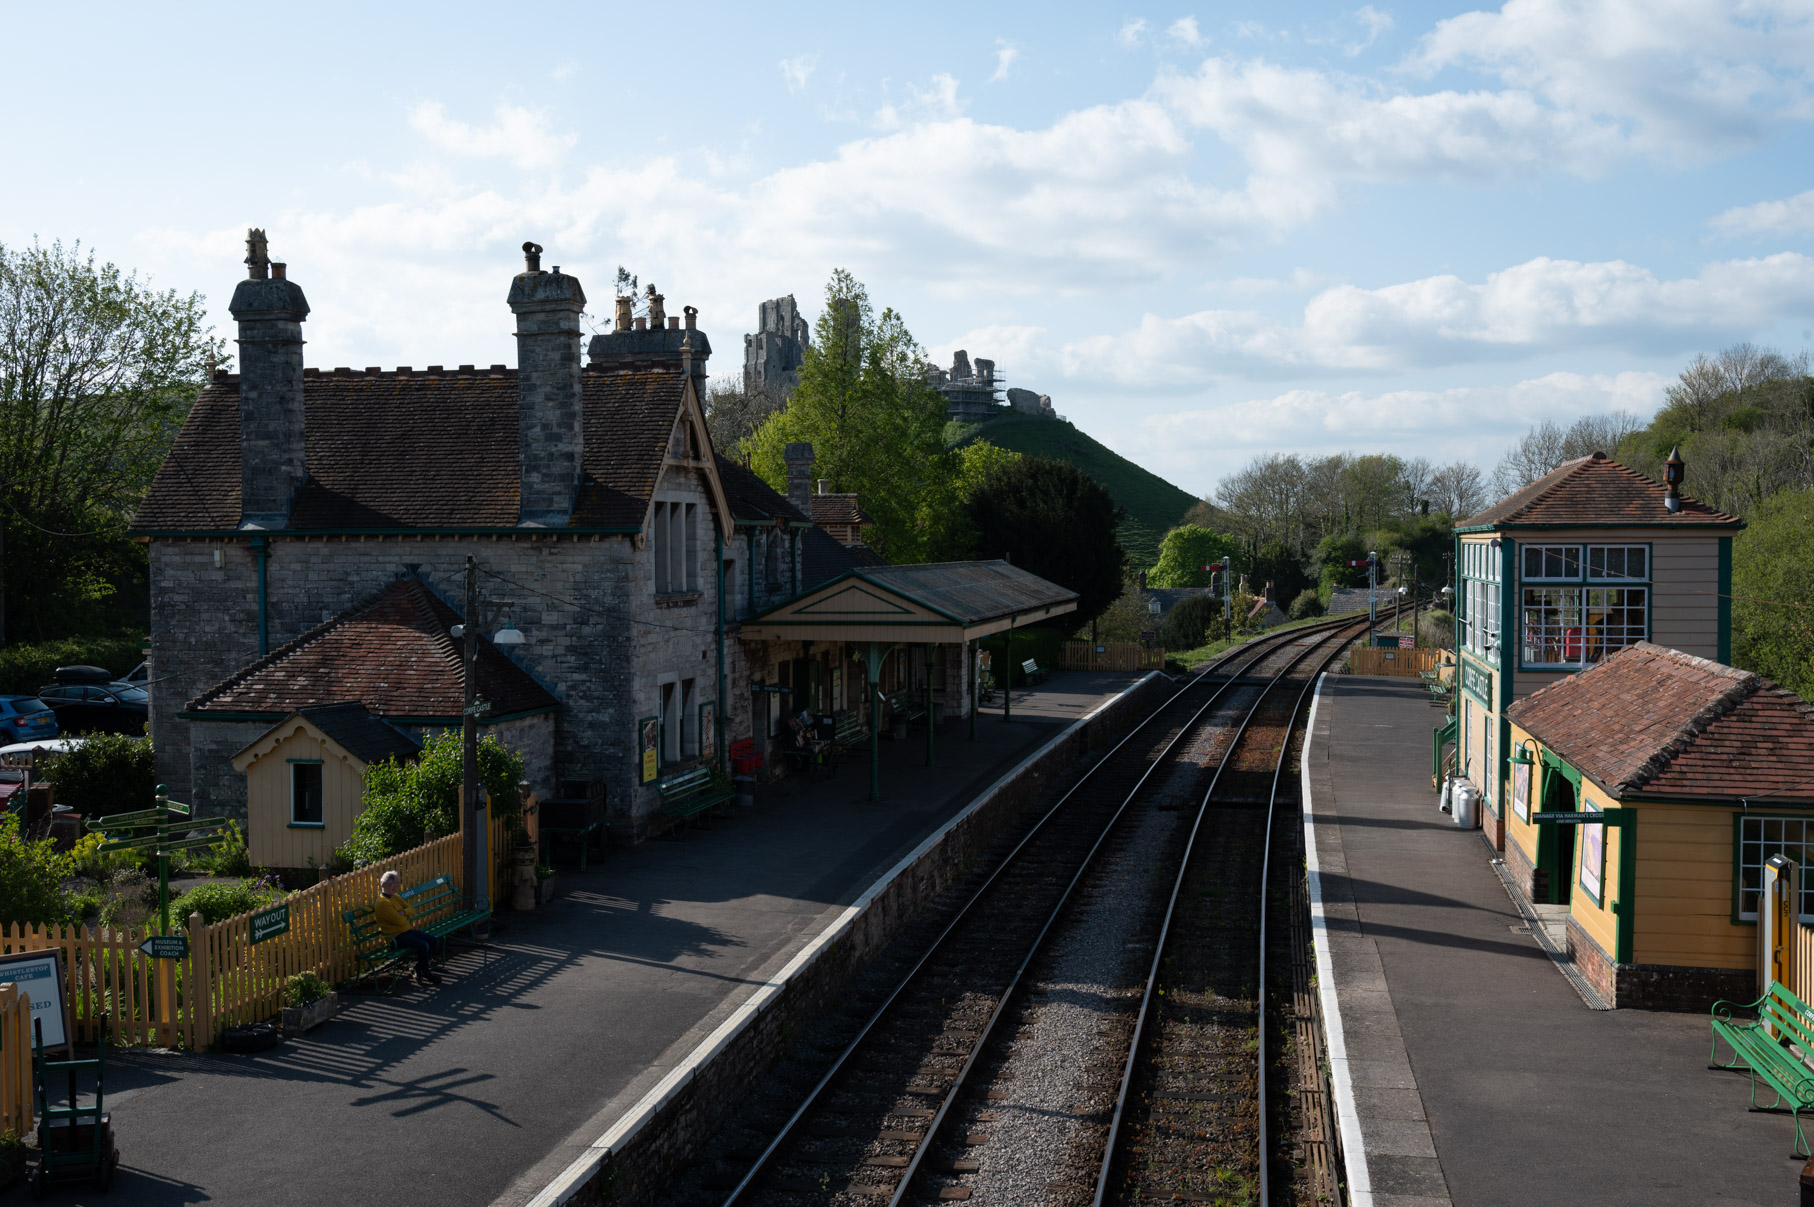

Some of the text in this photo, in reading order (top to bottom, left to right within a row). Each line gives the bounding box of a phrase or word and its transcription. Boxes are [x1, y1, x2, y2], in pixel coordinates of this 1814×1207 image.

[1465, 665, 1488, 701] CORFE CASTLE
[463, 702, 491, 716] CORFE CASTLE
